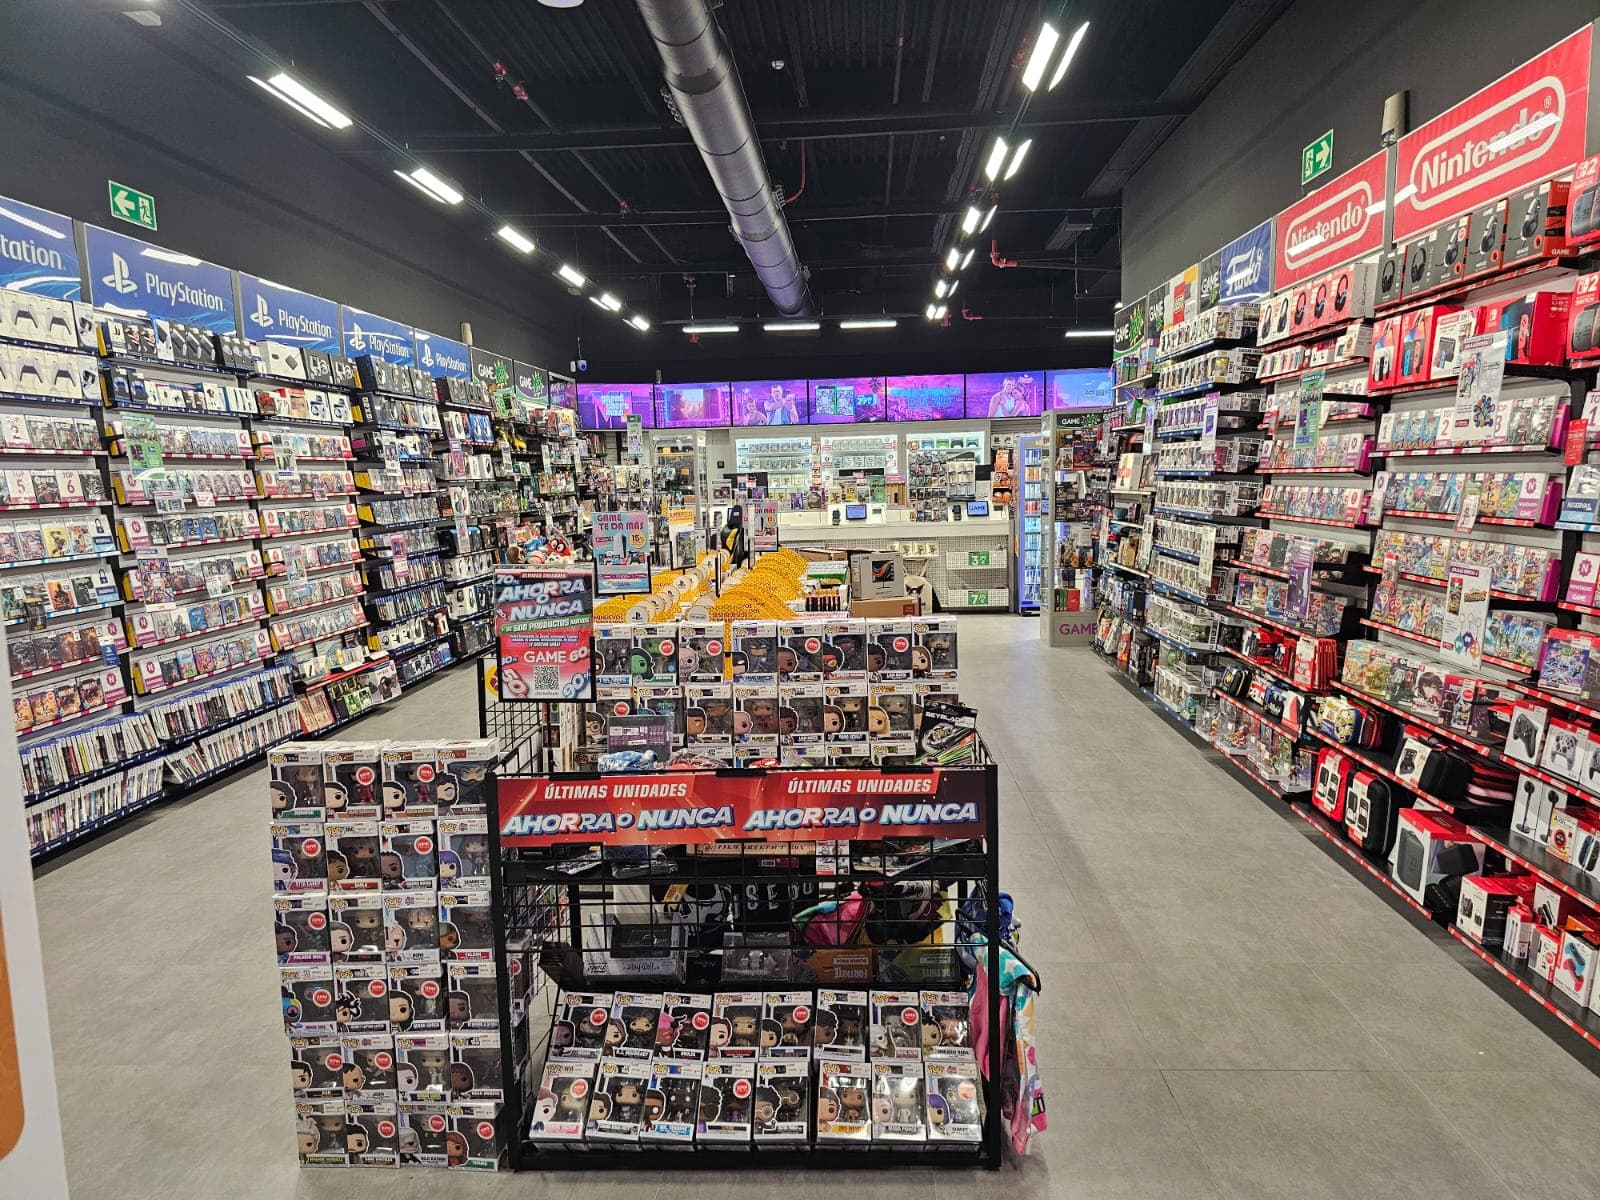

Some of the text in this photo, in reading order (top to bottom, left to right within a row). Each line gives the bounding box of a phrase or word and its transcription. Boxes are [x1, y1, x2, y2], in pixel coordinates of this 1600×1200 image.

[1420, 107, 1548, 194] Nintendo
[1291, 202, 1362, 246] Nintendo
[145, 272, 224, 311] PlayStation
[1201, 270, 1219, 293] GAME
[279, 308, 332, 339] PlayStation
[1115, 323, 1130, 343] GAME
[370, 333, 409, 357] PlayStation
[436, 352, 468, 373] PlayStation
[478, 363, 495, 379] GAME
[520, 375, 532, 389] GAME
[17, 479, 26, 494] 5
[66, 479, 75, 494] 6
[969, 503, 986, 511] GAME
[597, 514, 621, 522] GAME
[599, 522, 609, 530] TE
[611, 522, 623, 530] DA
[498, 578, 586, 603] AHORRA
[509, 599, 584, 622] NUNCA
[1060, 623, 1098, 635] GAME
[523, 650, 567, 663] GAME
[544, 782, 687, 799] ÚLTIMAS UNIDADES
[787, 777, 931, 794] ÚLTIMAS UNIDADES
[502, 811, 616, 836] AHORRA
[636, 805, 735, 832] NUNCA
[742, 806, 859, 830] AHORRA
[879, 802, 978, 825] NUNCA
